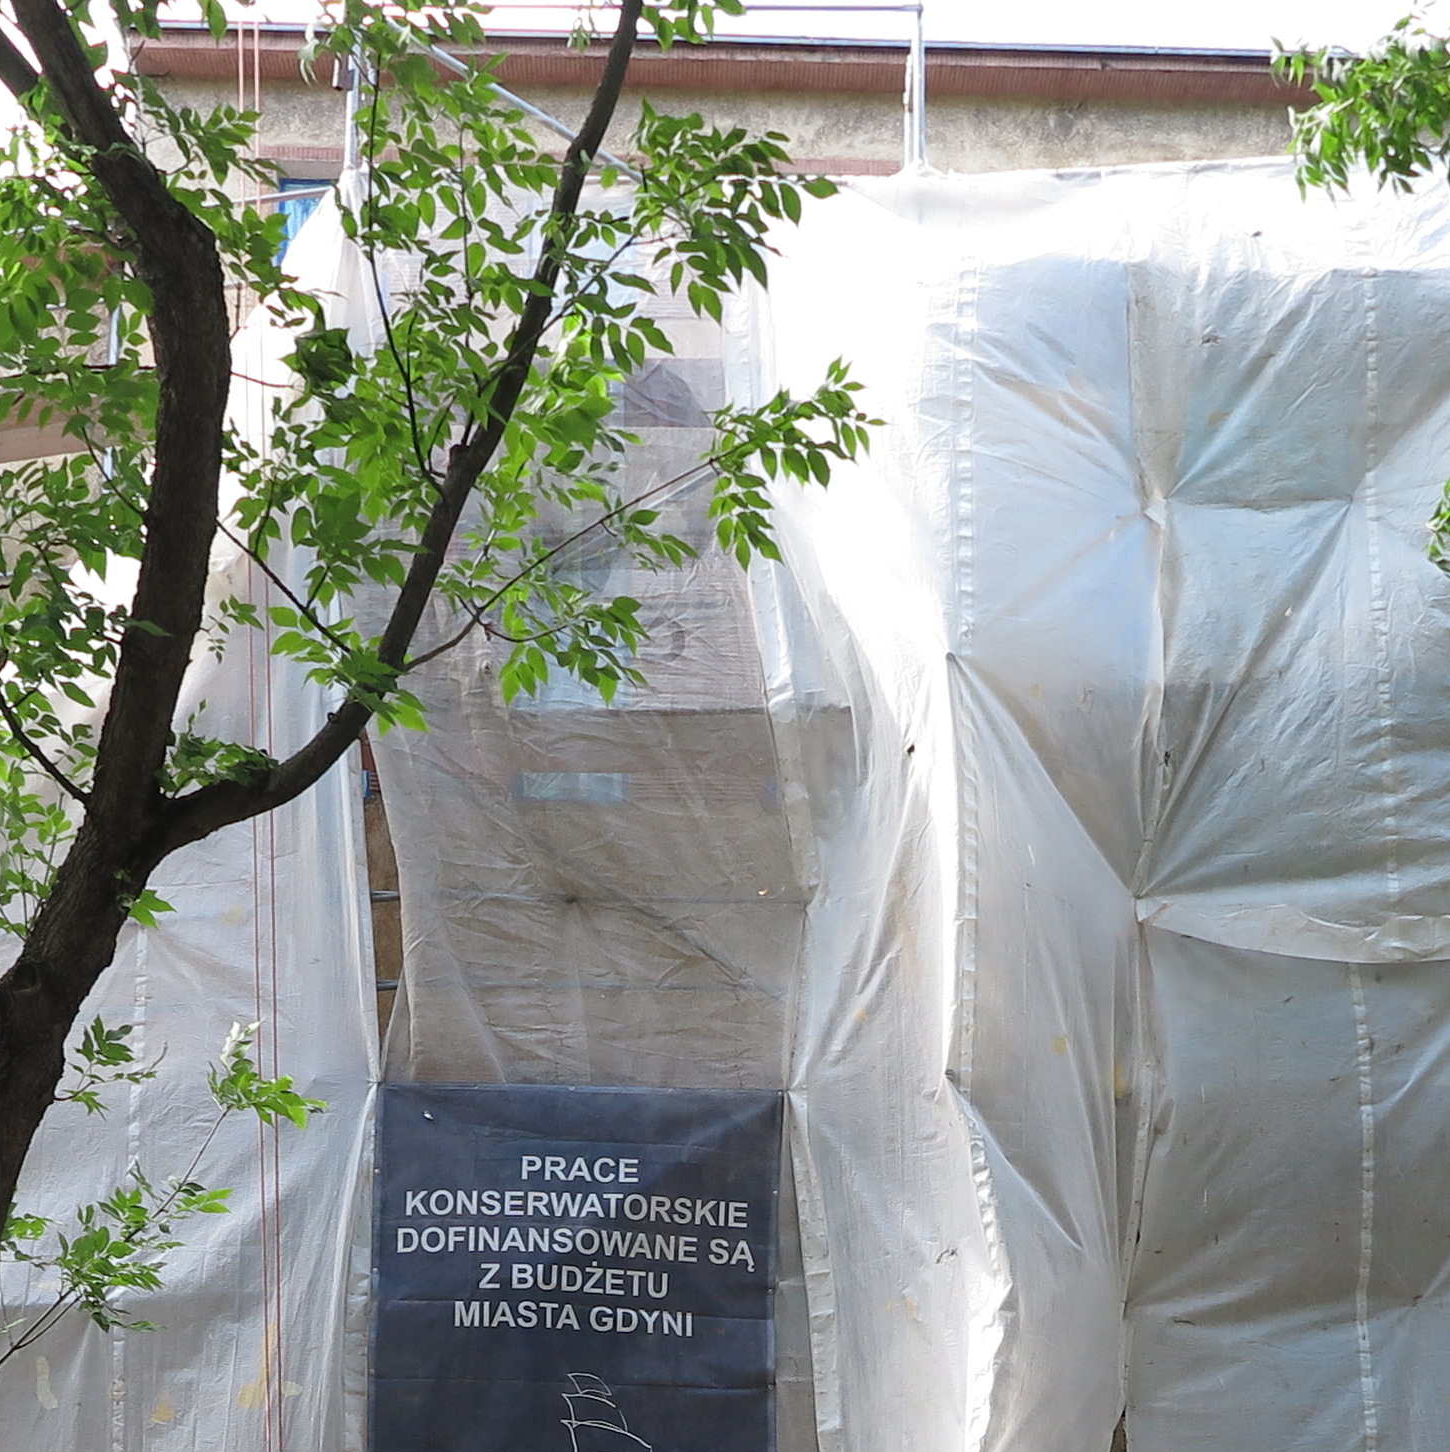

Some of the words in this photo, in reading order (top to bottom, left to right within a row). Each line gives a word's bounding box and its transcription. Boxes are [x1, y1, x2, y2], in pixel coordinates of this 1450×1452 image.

[521, 1155, 639, 1183] PRACE
[404, 1190, 748, 1229] KONSERWATORSKIE
[396, 1226, 698, 1264] DOFINANSOWANE
[708, 1238, 755, 1273] SĄ
[478, 1263, 501, 1289] Z
[511, 1260, 670, 1299] BUDŻETU
[454, 1301, 580, 1331] MIASTA
[589, 1307, 693, 1337] GDYNI
